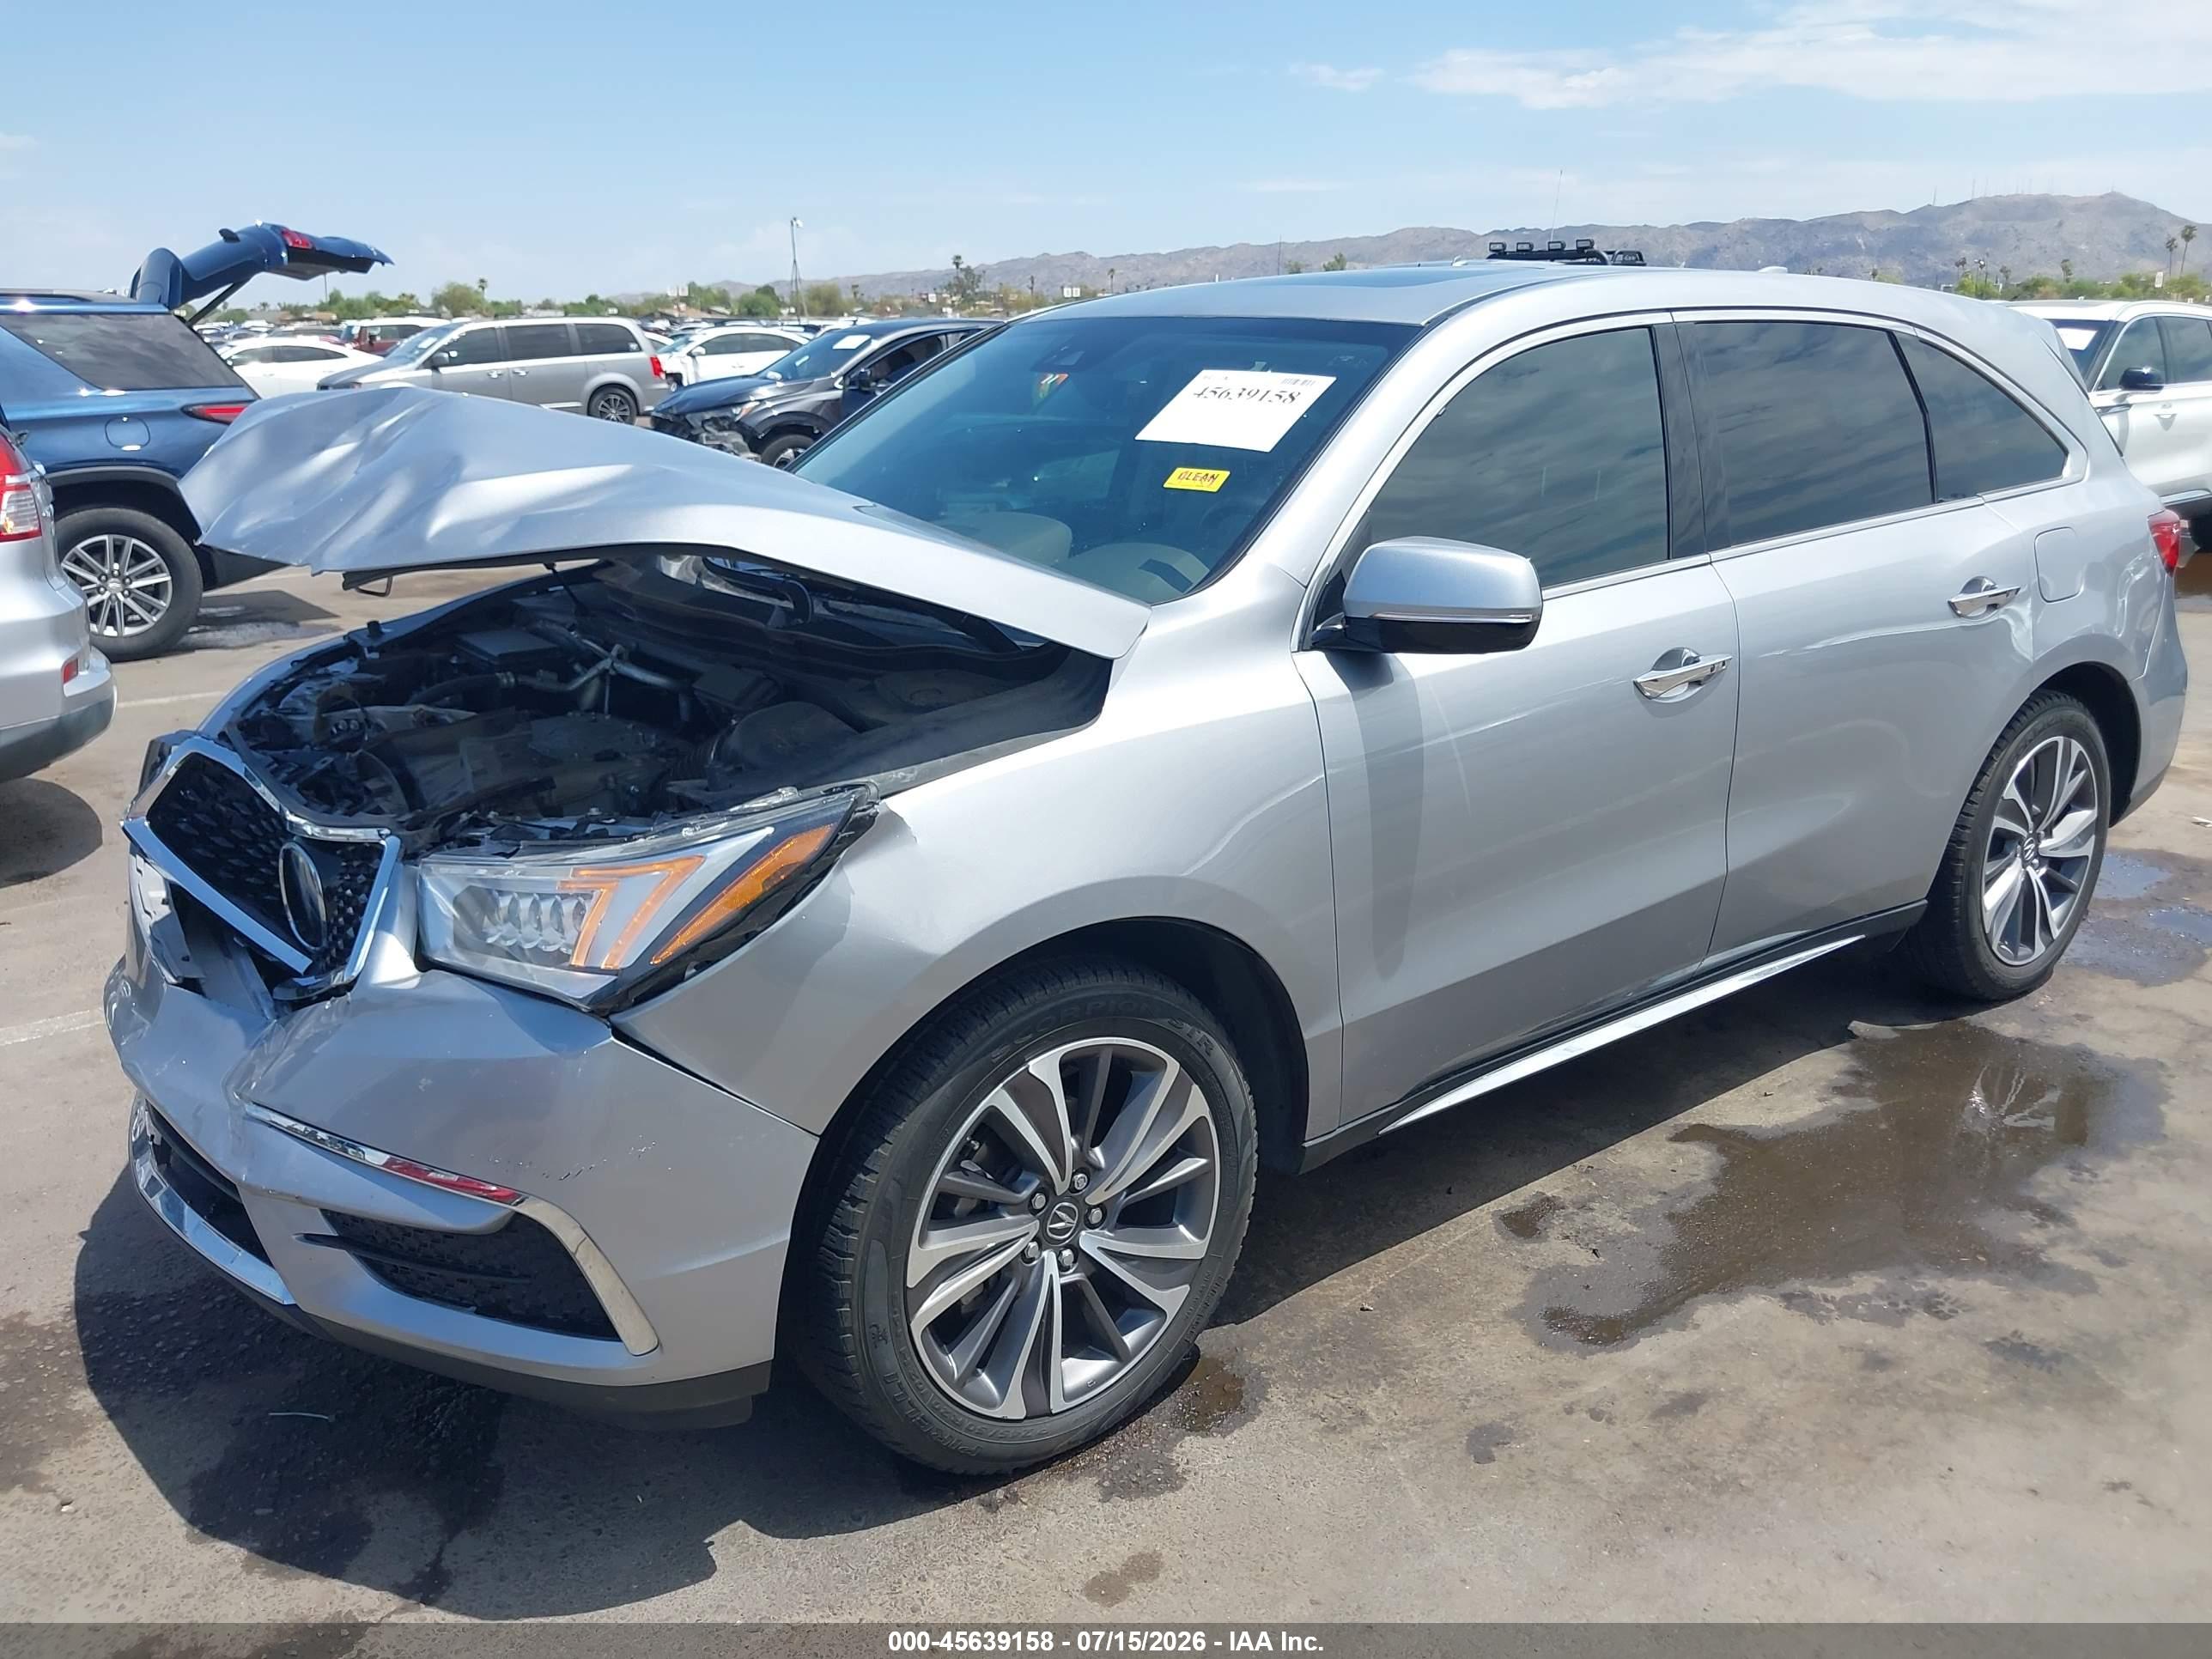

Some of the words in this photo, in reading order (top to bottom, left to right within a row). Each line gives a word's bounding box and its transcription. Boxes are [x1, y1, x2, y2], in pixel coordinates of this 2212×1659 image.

[1193, 386, 1301, 404] 45639158
[991, 999, 1156, 1063] SCORPION
[1167, 1017, 1216, 1056] STR
[884, 1372, 983, 1457] PIRELLI
